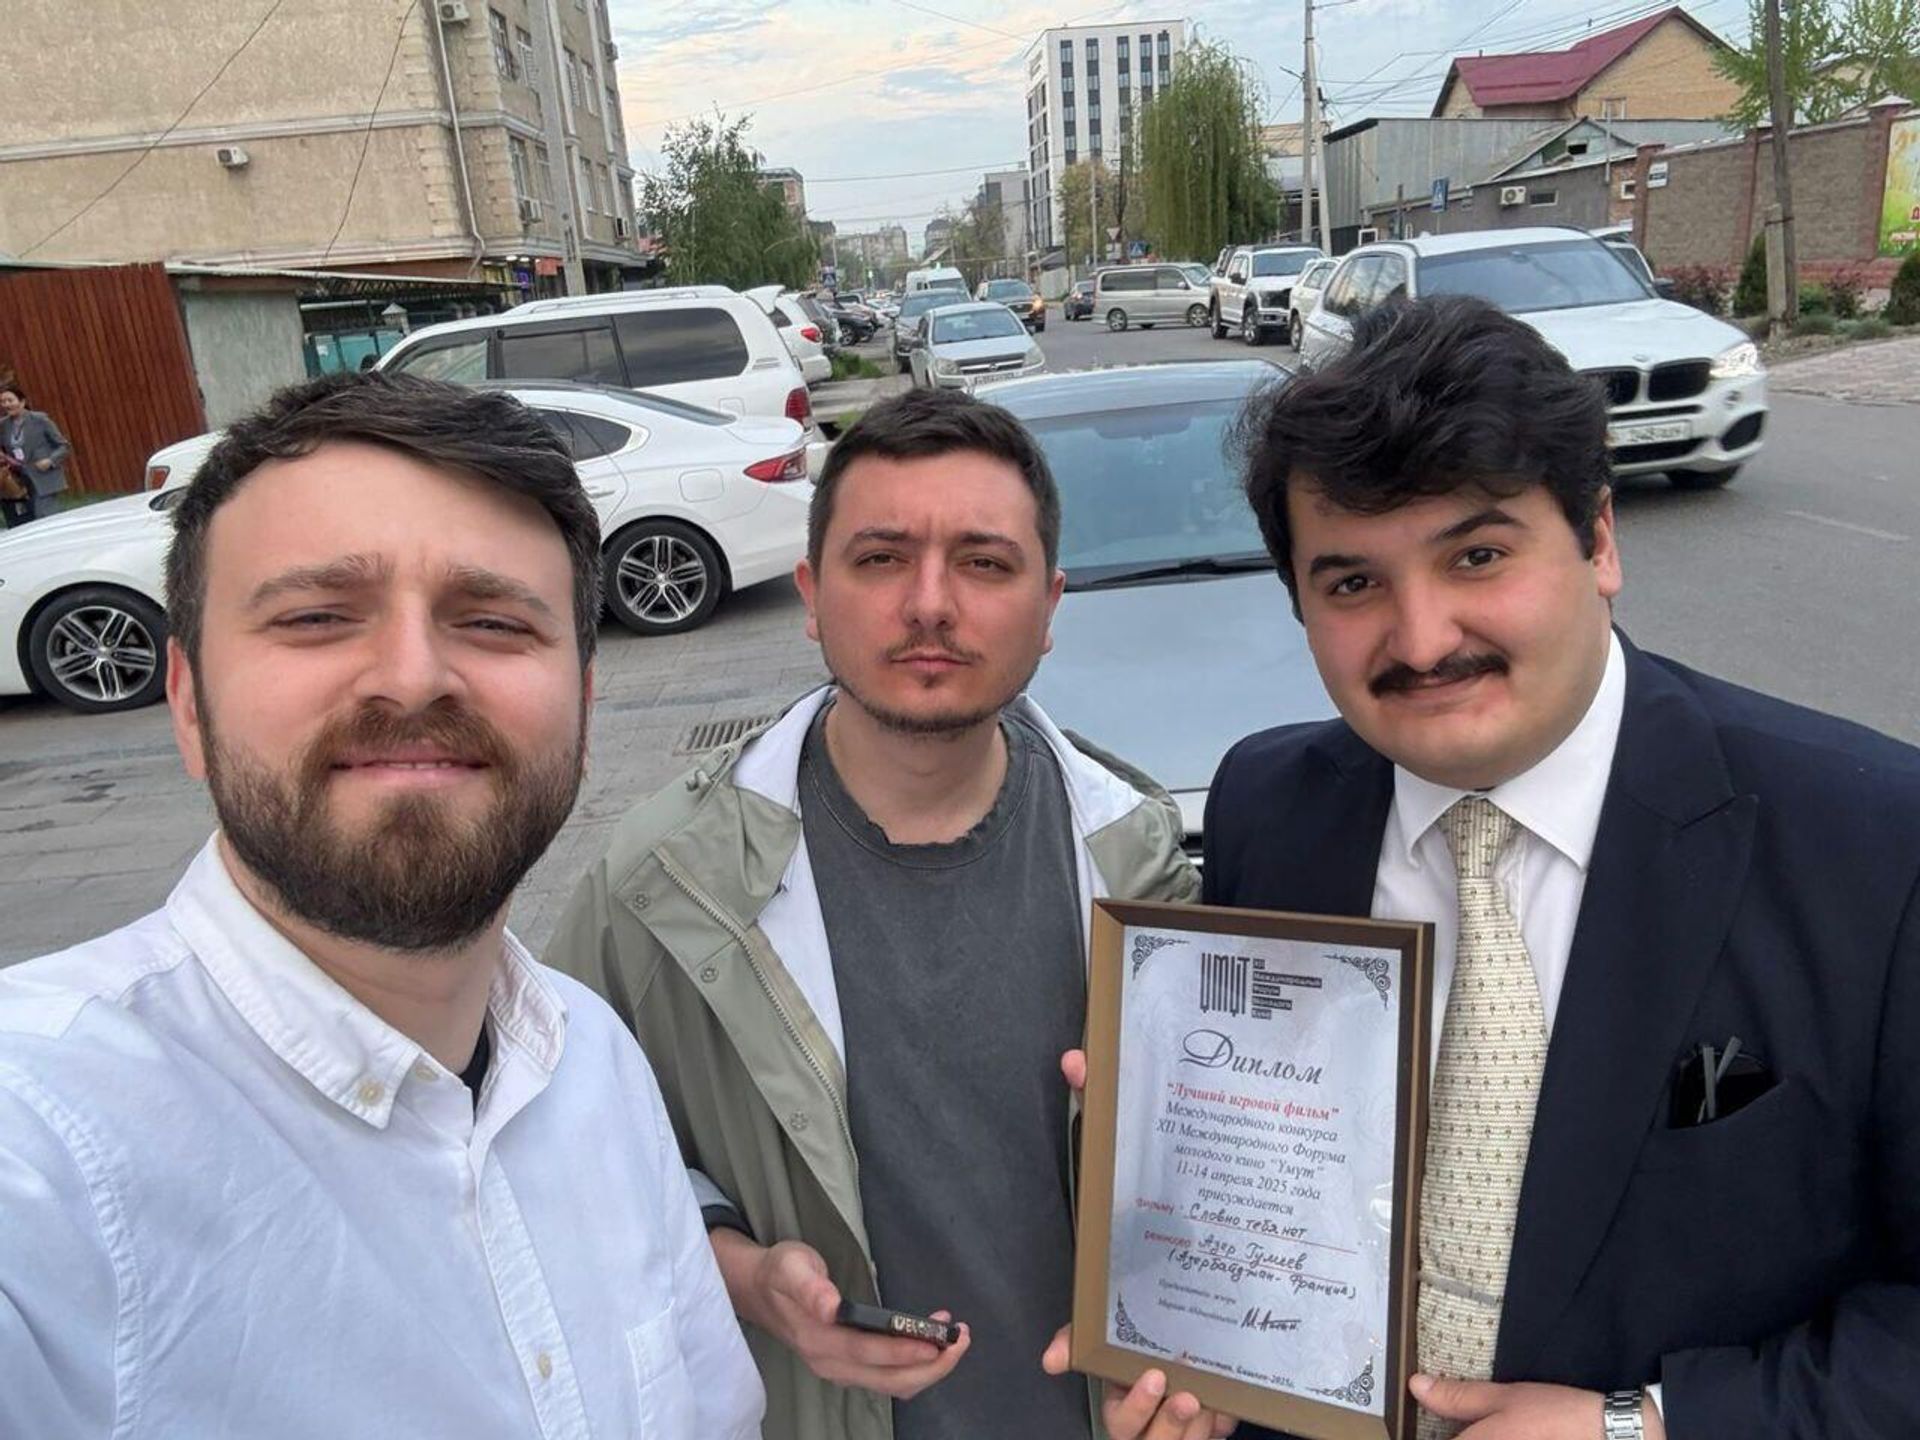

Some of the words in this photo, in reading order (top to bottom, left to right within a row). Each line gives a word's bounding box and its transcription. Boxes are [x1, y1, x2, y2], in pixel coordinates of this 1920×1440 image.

[1178, 1029, 1325, 1084] Диплом
[1165, 1101, 1275, 1132] Международного
[1278, 1122, 1338, 1143] конкурса
[1229, 1095, 1281, 1114] игровой
[1283, 1101, 1340, 1121] фильм"
[1173, 1144, 1233, 1164] молодого
[1235, 1157, 1265, 1170] кино
[1179, 1123, 1289, 1154] Международного
[1292, 1143, 1346, 1164] Форума
[1175, 1160, 1207, 1179] 11-14
[1210, 1171, 1253, 1188] апреля
[1256, 1175, 1287, 1194] 2025
[1290, 1184, 1321, 1201] года
[1198, 1186, 1294, 1216] присуждается
[1282, 1226, 1308, 1240] нет
